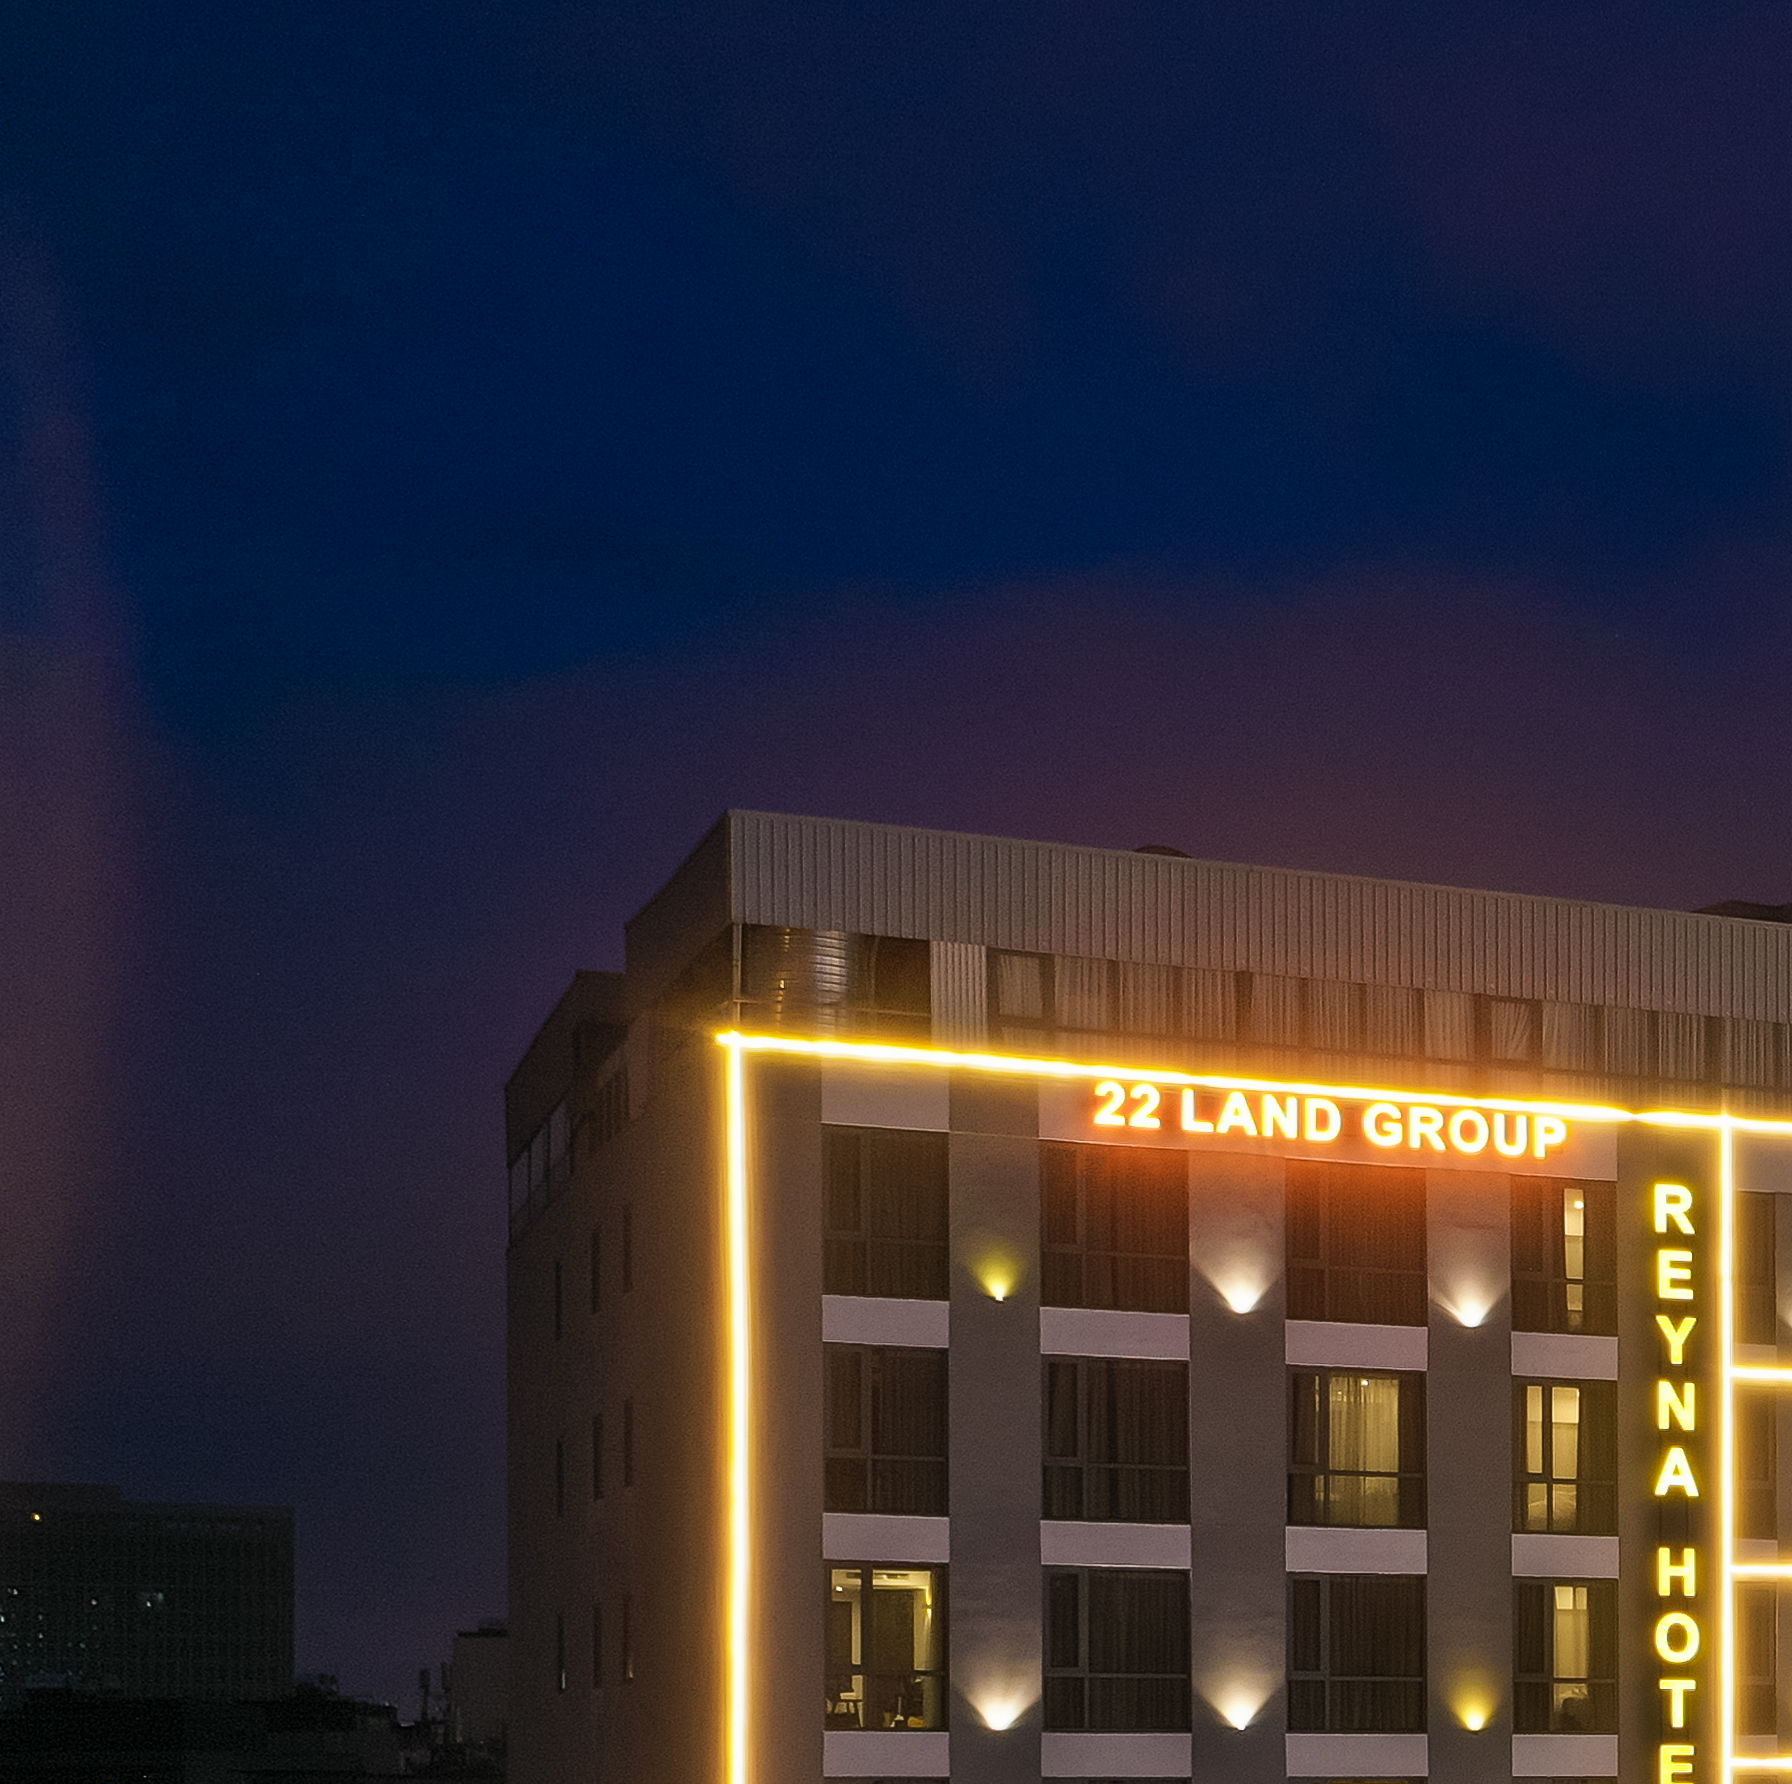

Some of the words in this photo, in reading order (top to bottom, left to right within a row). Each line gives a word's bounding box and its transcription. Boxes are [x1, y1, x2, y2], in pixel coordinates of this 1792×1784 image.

[1093, 1080, 1162, 1129] 22
[1180, 1087, 1342, 1143] LAND
[1362, 1101, 1568, 1160] GROUP
[1653, 1182, 1700, 1498] REYNA
